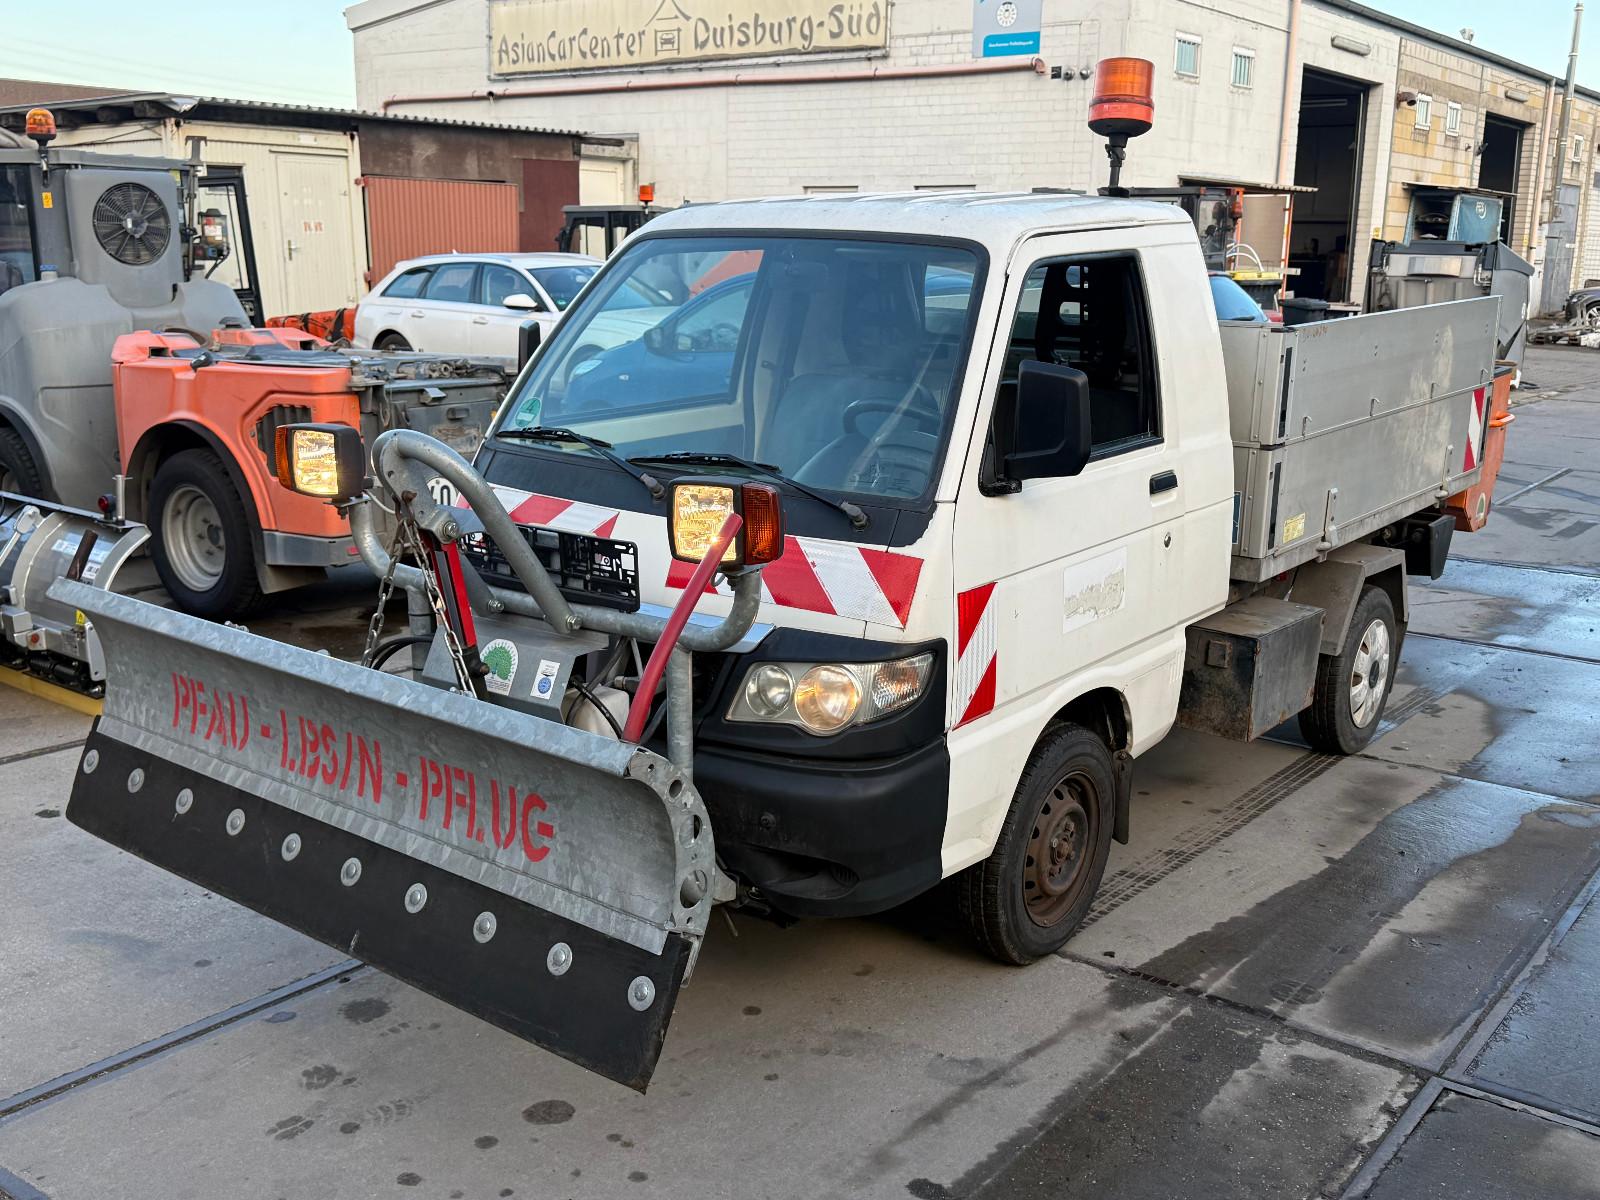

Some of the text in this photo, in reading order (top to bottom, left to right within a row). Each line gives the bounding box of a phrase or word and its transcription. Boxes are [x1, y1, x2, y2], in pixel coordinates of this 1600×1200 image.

[498, 1, 881, 66] AsianCarCenter Duisburg-Süd
[172, 672, 249, 752] PFAU
[419, 755, 554, 862] PFLUG
